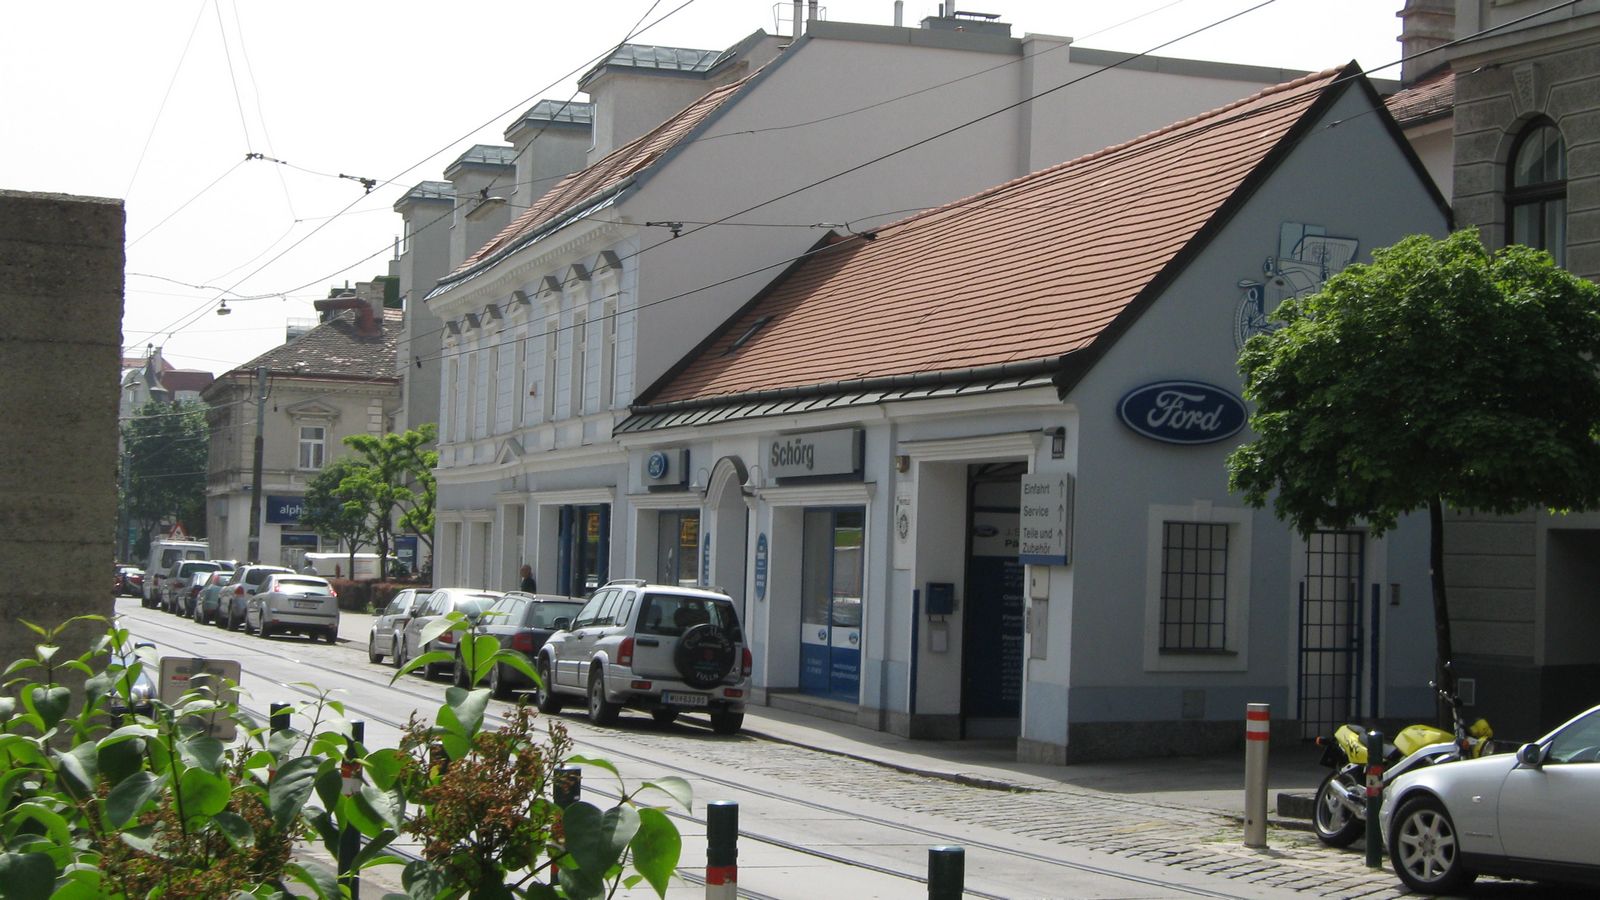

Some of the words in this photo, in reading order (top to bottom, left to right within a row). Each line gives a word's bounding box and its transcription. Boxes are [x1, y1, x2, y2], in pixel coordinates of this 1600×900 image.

[1146, 390, 1225, 431] Ford
[771, 438, 815, 470] Schörg
[1024, 483, 1050, 495] Einfahrt
[1023, 505, 1049, 517] Service
[1023, 527, 1039, 539] Teile
[1039, 528, 1053, 539] und
[1022, 542, 1051, 554] Zubehör
